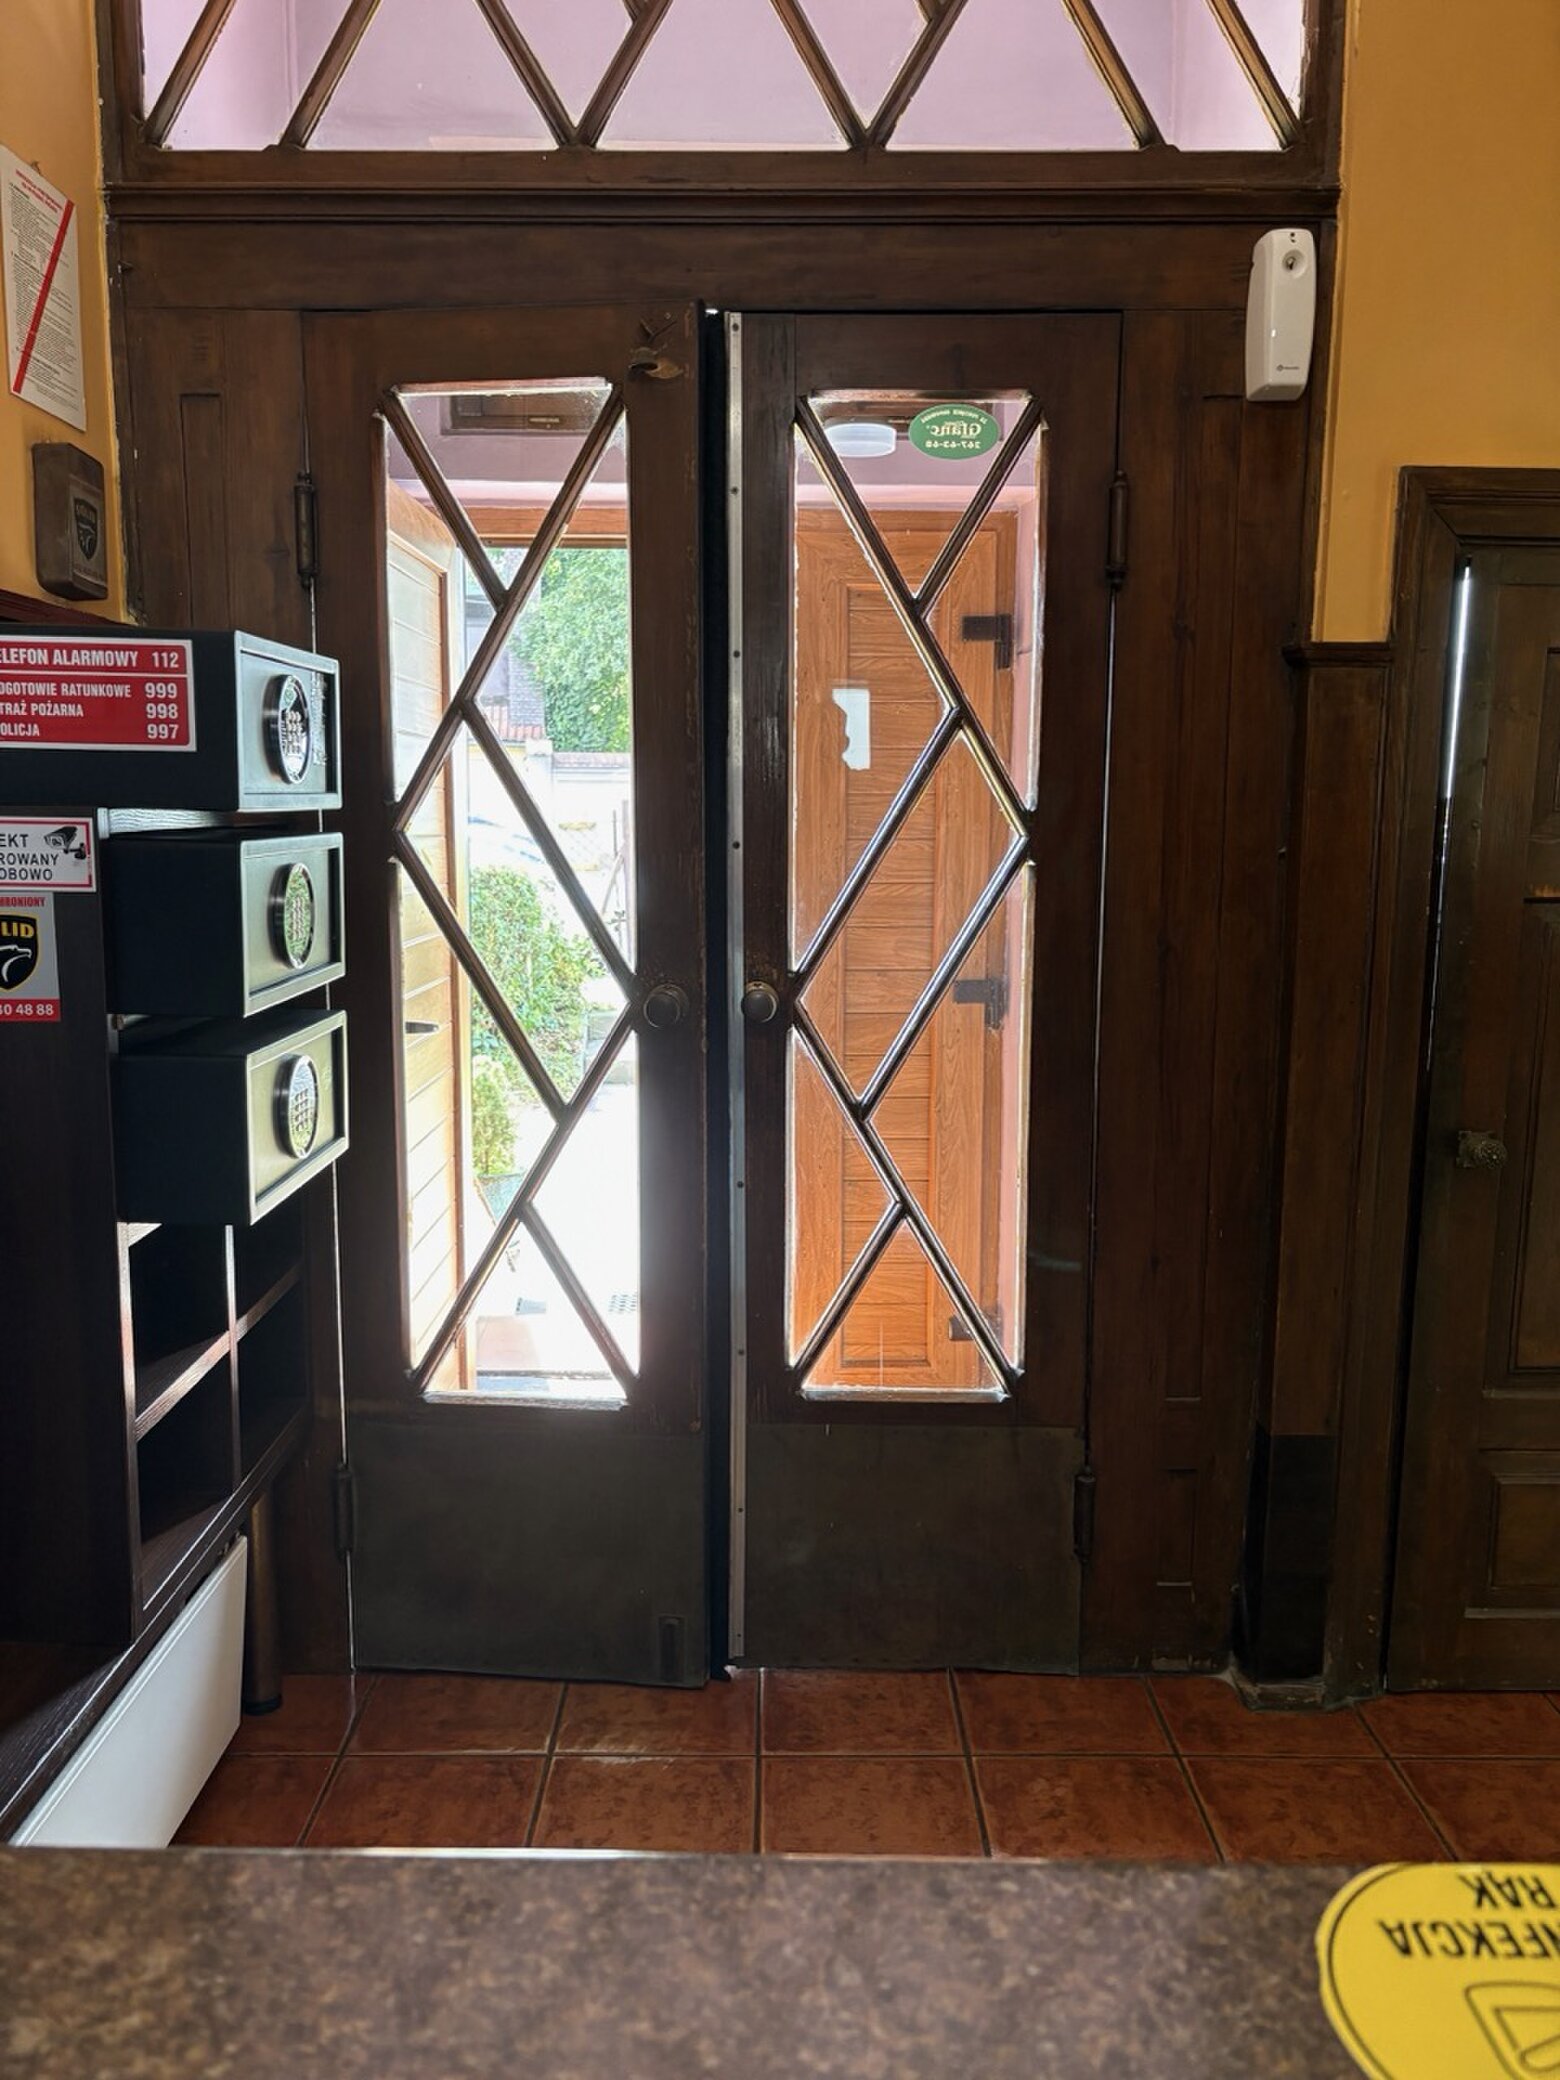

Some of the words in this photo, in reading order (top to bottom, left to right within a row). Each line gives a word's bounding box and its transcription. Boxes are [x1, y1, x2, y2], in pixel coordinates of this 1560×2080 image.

[0, 647, 49, 665] LEFON
[53, 649, 138, 667] ALARMOWY
[152, 651, 179, 668] 112
[61, 683, 132, 698] RATUNKOWE
[145, 682, 178, 699] 999
[31, 700, 84, 717] POŻARNA
[146, 703, 179, 719] 998
[0, 722, 40, 736] OLICJA
[147, 724, 179, 739] 997
[0, 867, 53, 881] OBOWO
[1, 921, 35, 938] LID
[15, 1003, 33, 1016] 48
[36, 1003, 54, 1016] 88
[1457, 1872, 1557, 1909] RĄK
